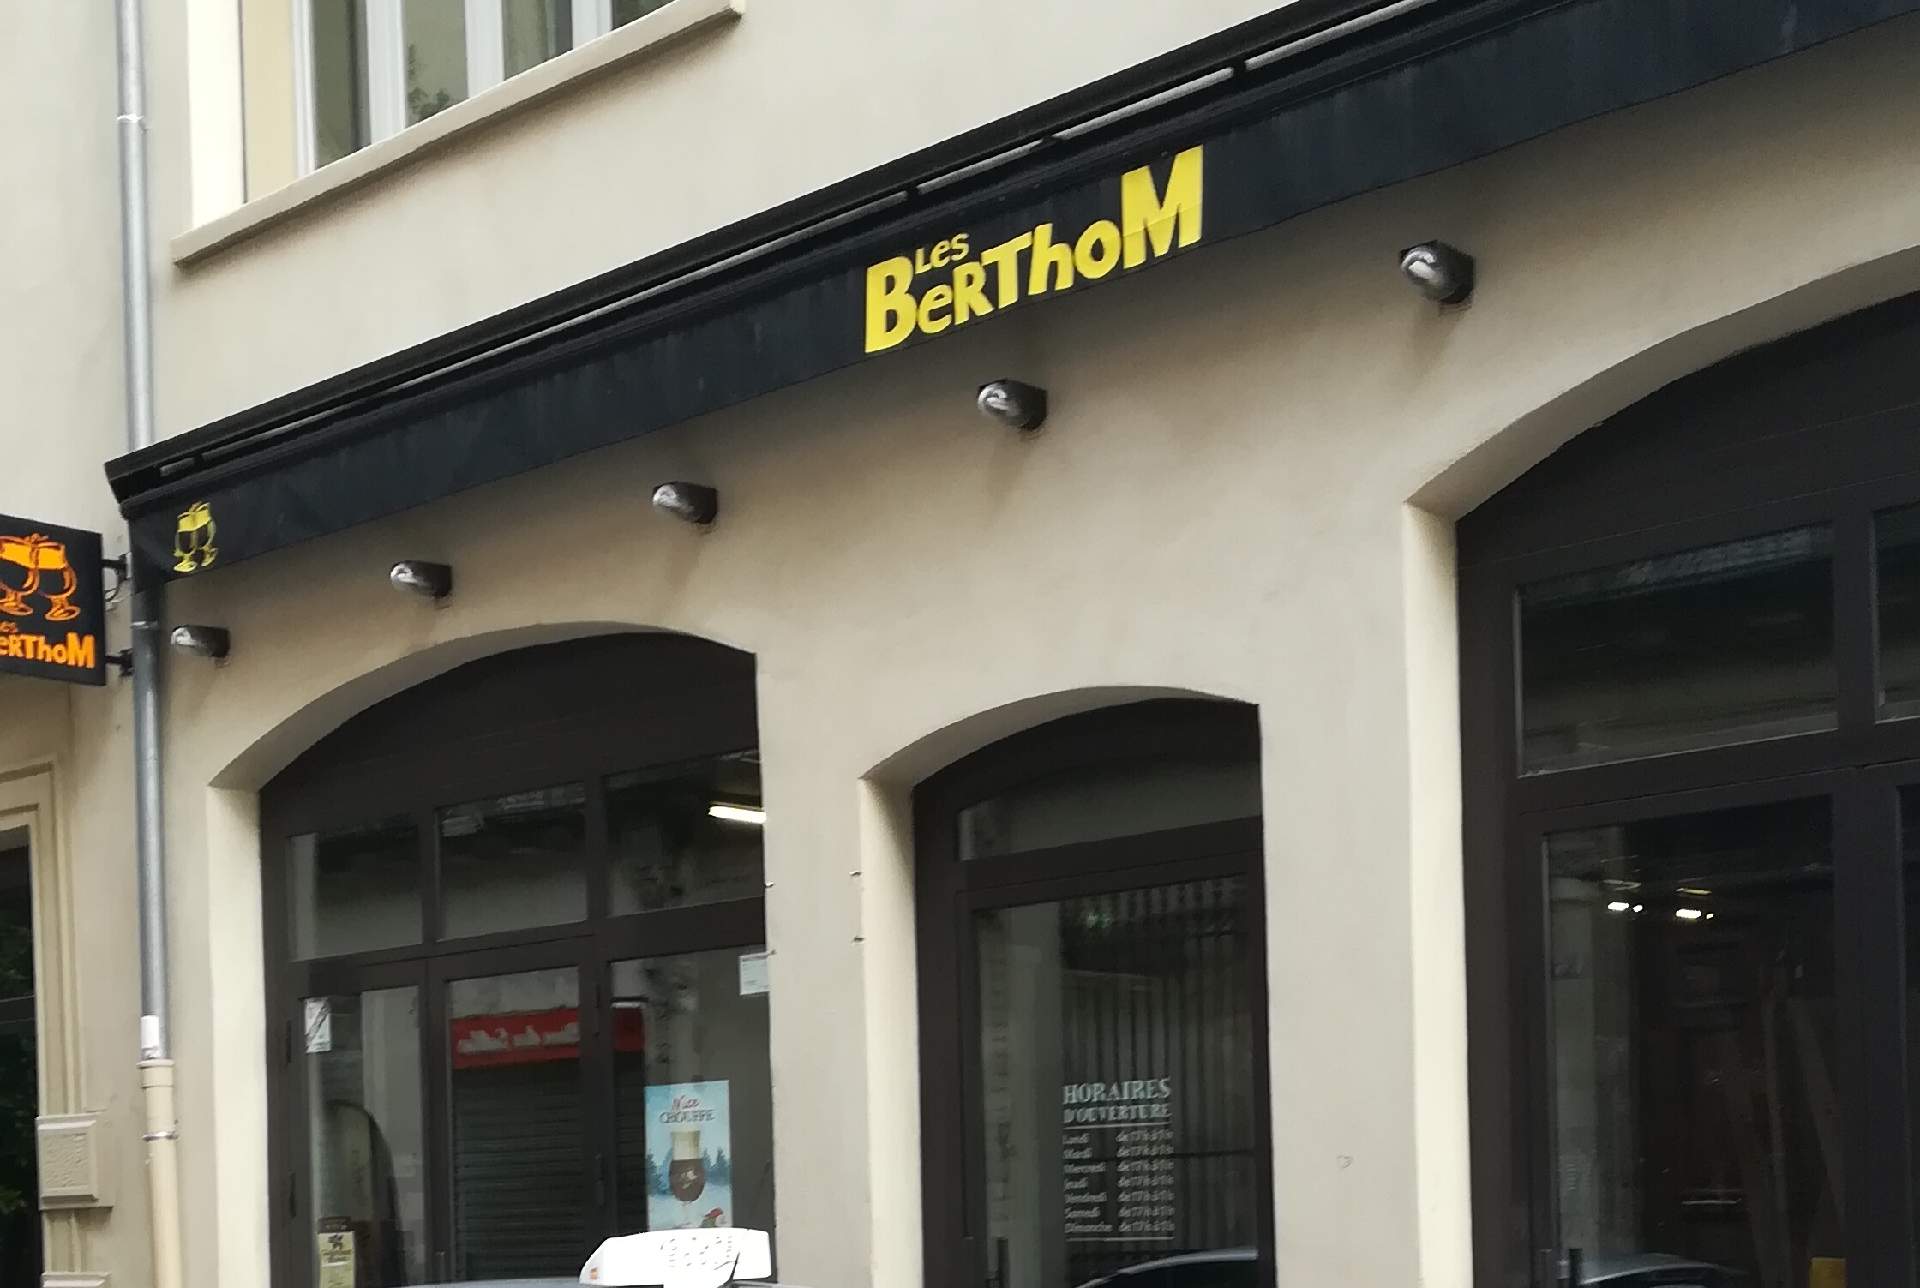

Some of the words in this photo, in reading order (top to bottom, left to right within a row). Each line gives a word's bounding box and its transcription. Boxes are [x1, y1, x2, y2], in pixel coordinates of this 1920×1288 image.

[0, 632, 95, 668] eRThoM
[1063, 1078, 1171, 1105] HORAIRES
[1064, 1103, 1172, 1123] D'OUVERTURE
